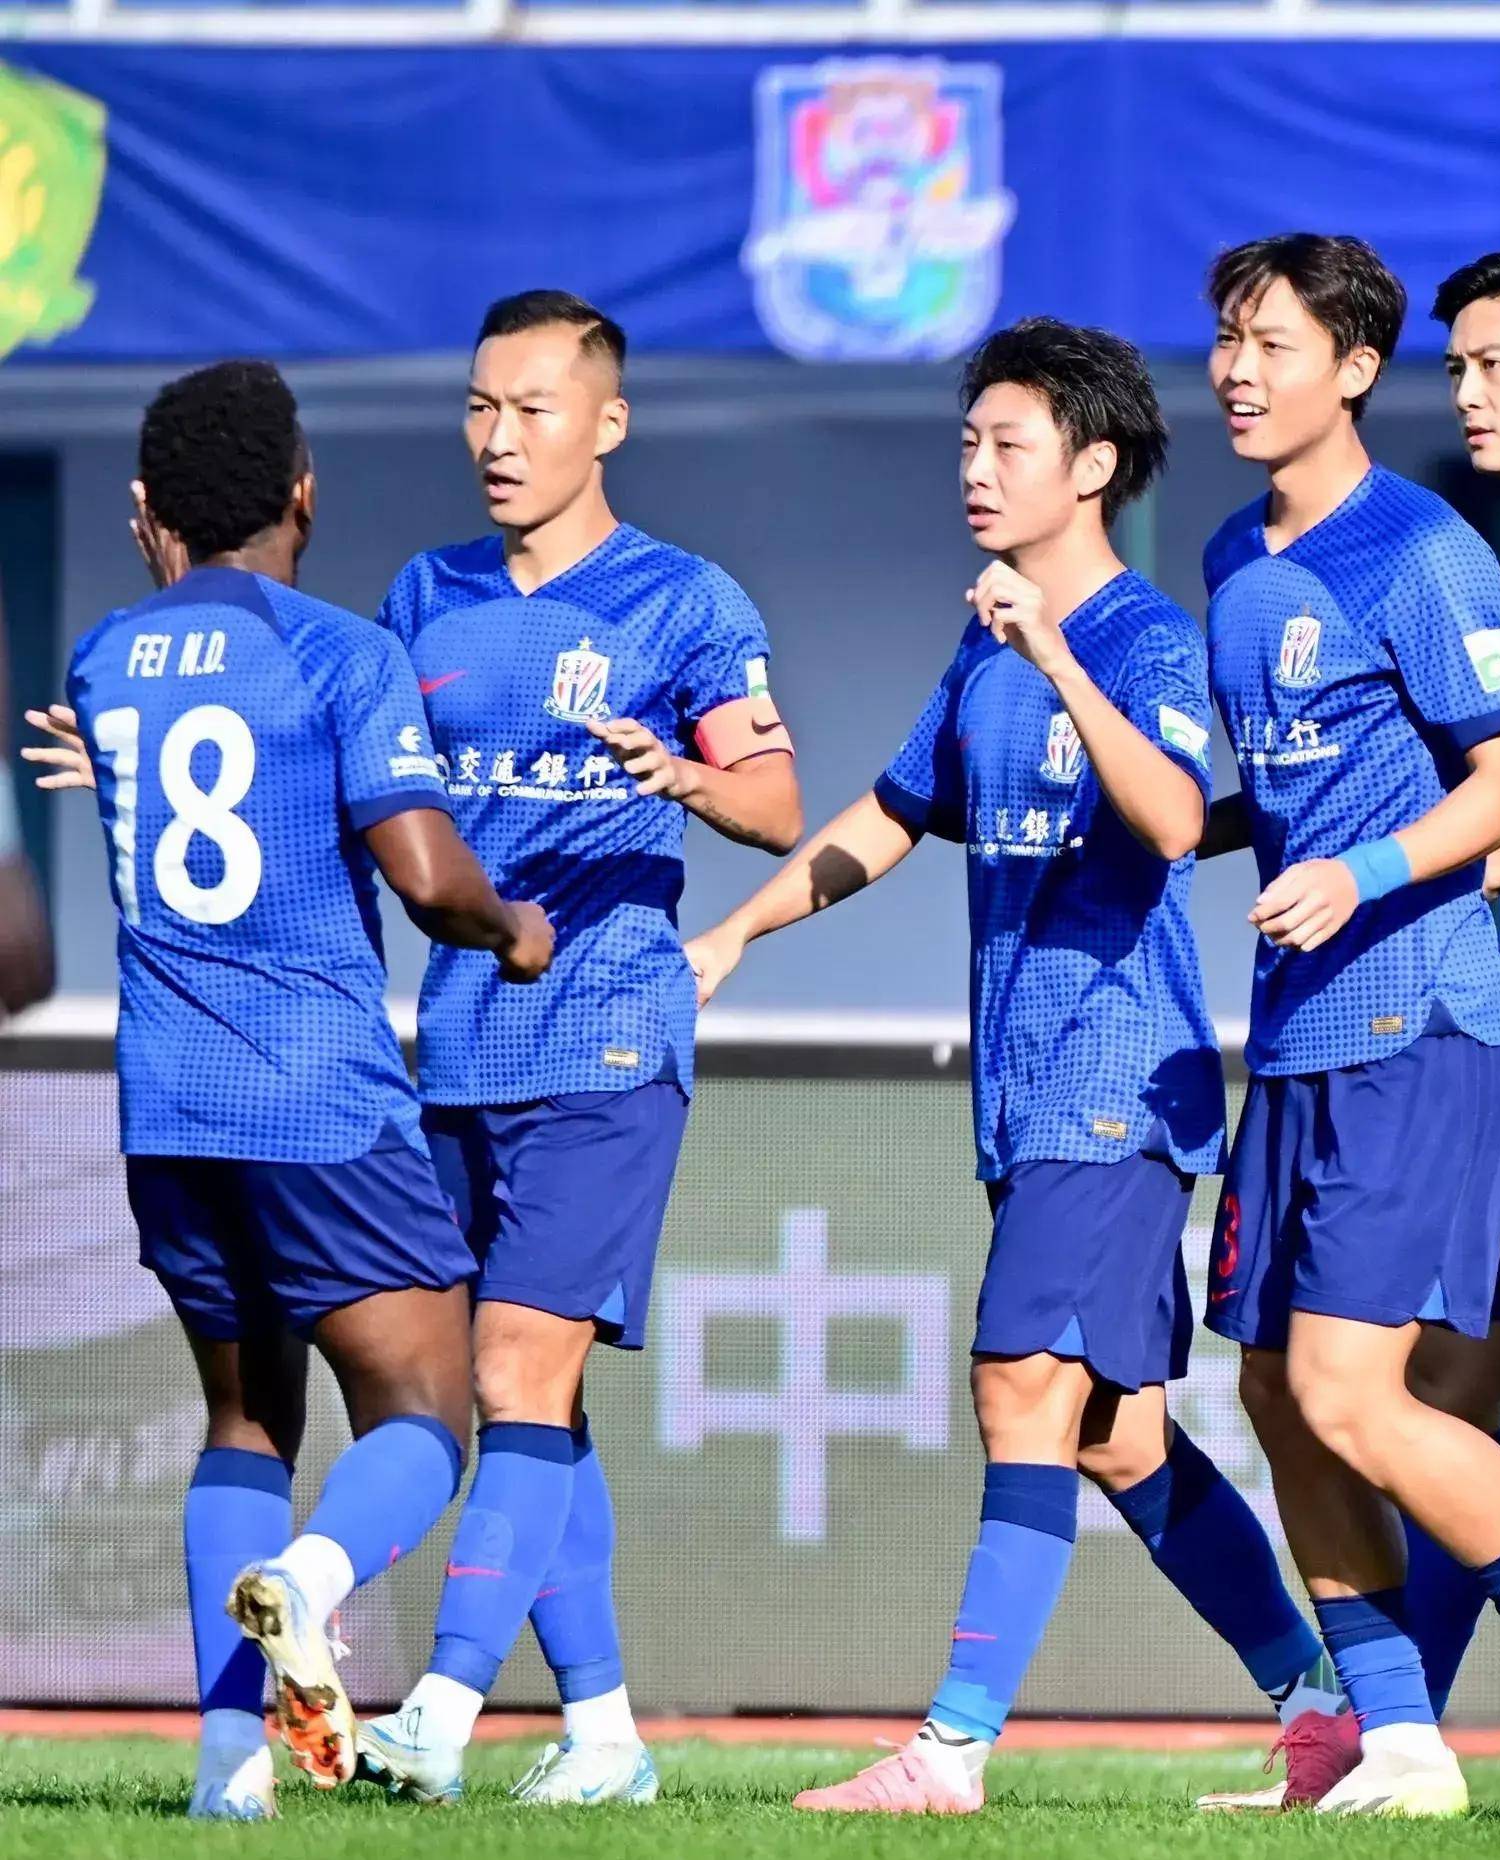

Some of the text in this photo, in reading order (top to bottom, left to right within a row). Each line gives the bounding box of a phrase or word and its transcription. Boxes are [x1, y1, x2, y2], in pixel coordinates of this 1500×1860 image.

[127, 634, 173, 678] FEI
[457, 746, 615, 788] 交通銀行
[448, 783, 628, 802] BANK OF COMMUNICATIONS
[94, 704, 263, 925] 18
